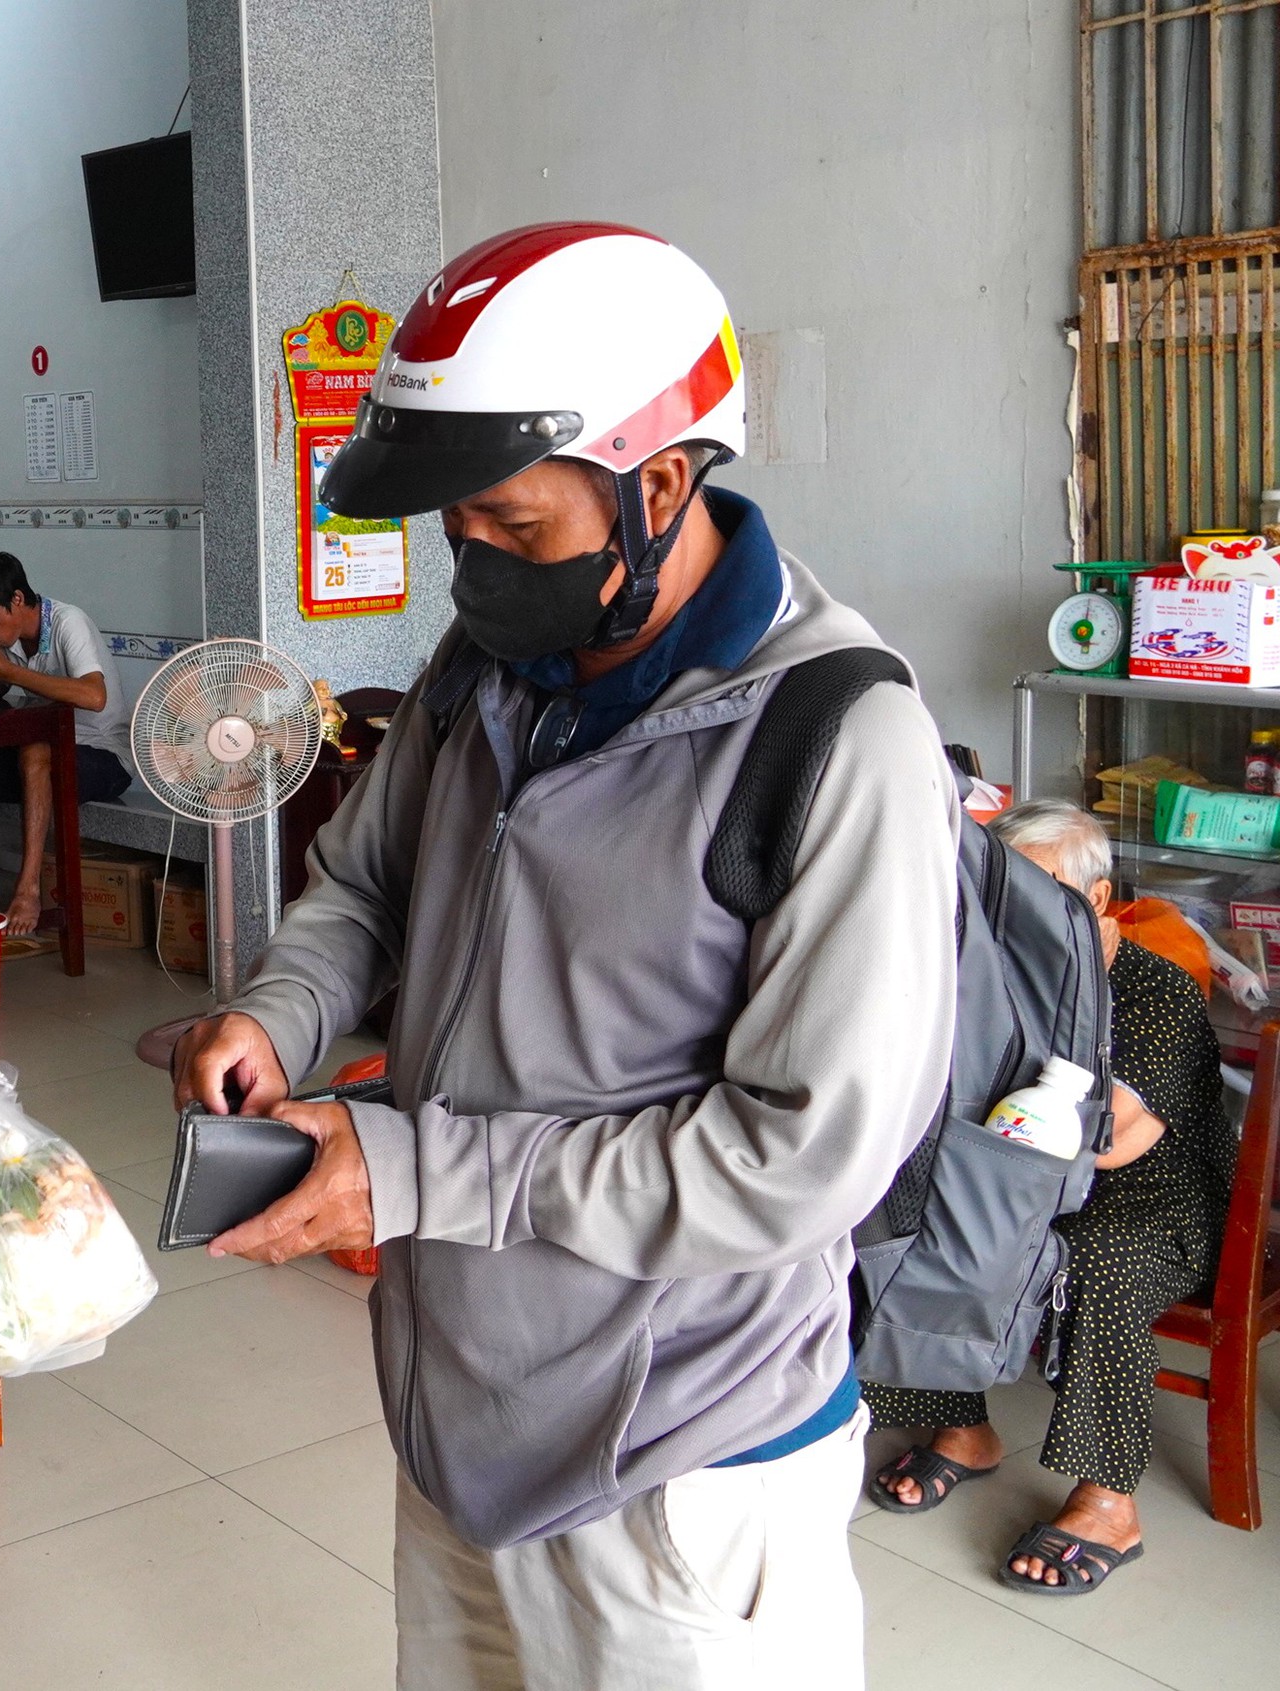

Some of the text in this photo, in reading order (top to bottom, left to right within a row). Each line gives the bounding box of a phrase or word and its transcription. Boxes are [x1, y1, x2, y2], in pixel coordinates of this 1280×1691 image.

[35, 352, 43, 370] 1
[324, 375, 355, 389] NAM
[387, 373, 428, 391] HDBank
[324, 566, 345, 587] 25
[225, 733, 241, 748] MITSU
[996, 1115, 1032, 1136] Number
